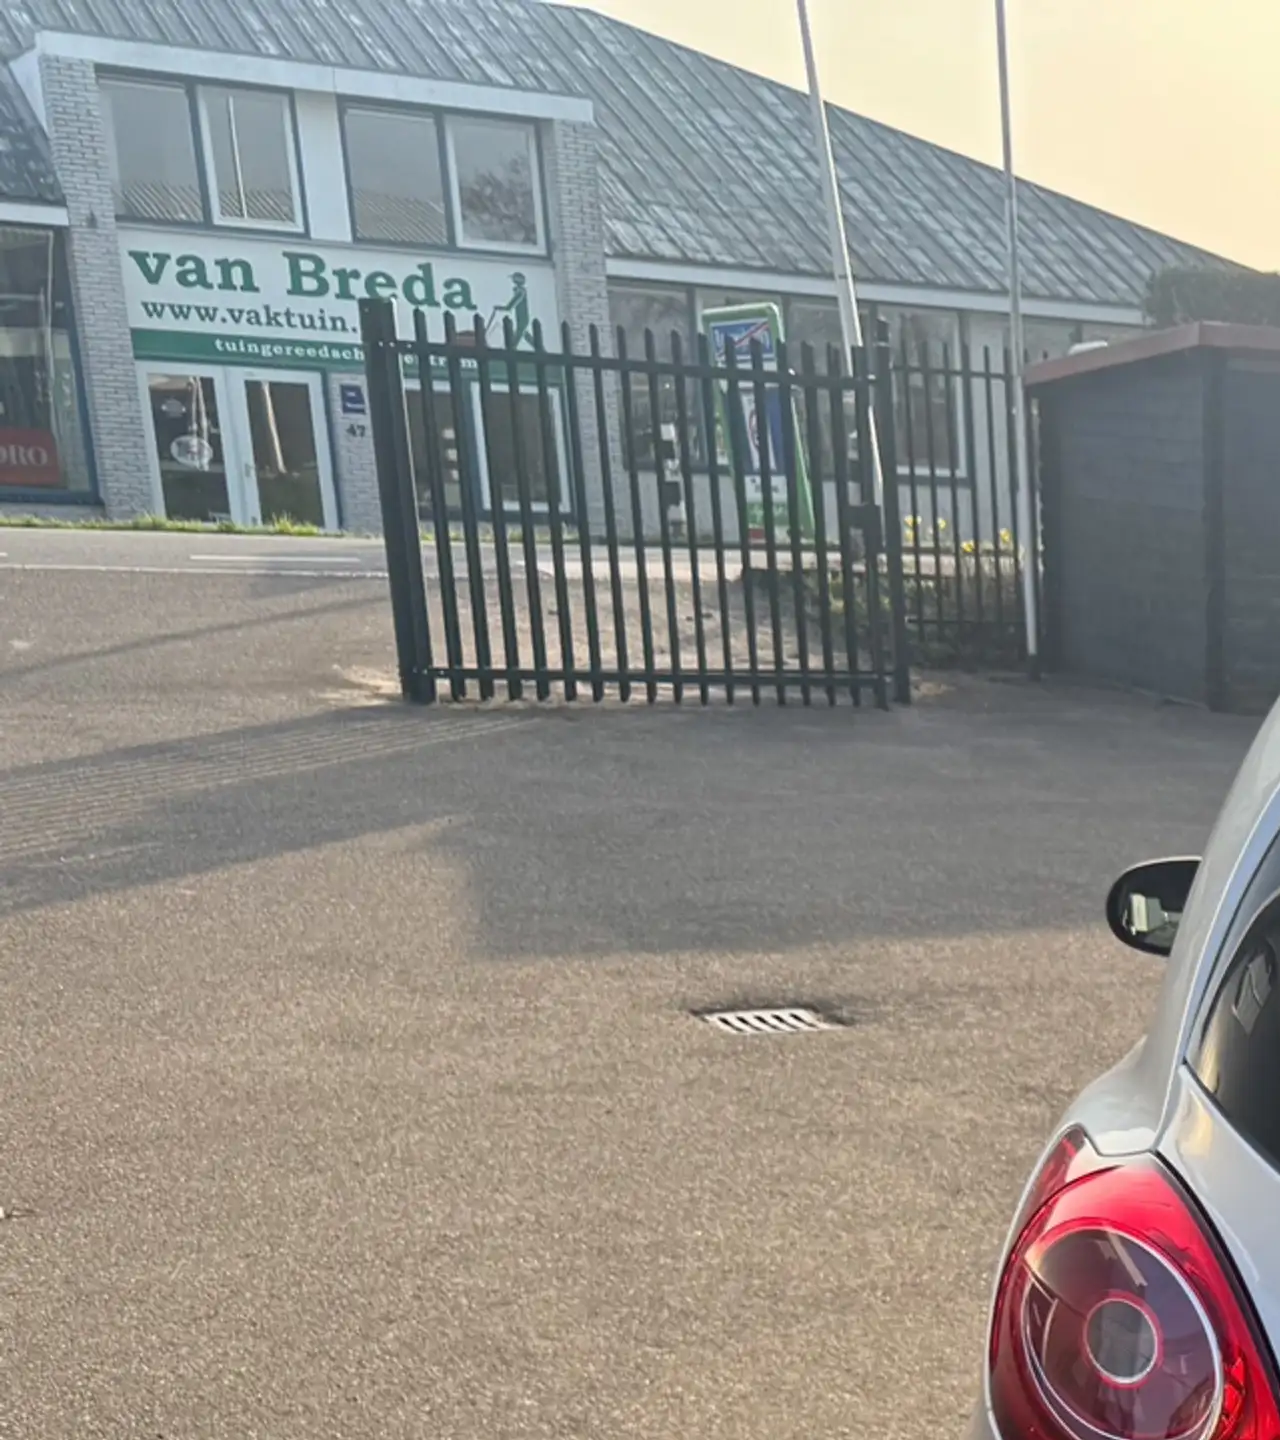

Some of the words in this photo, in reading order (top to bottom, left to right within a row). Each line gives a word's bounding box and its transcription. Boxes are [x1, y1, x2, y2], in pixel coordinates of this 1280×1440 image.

[127, 250, 260, 293] van
[281, 250, 478, 310] Breda
[140, 300, 358, 333] www.vaktuin.
